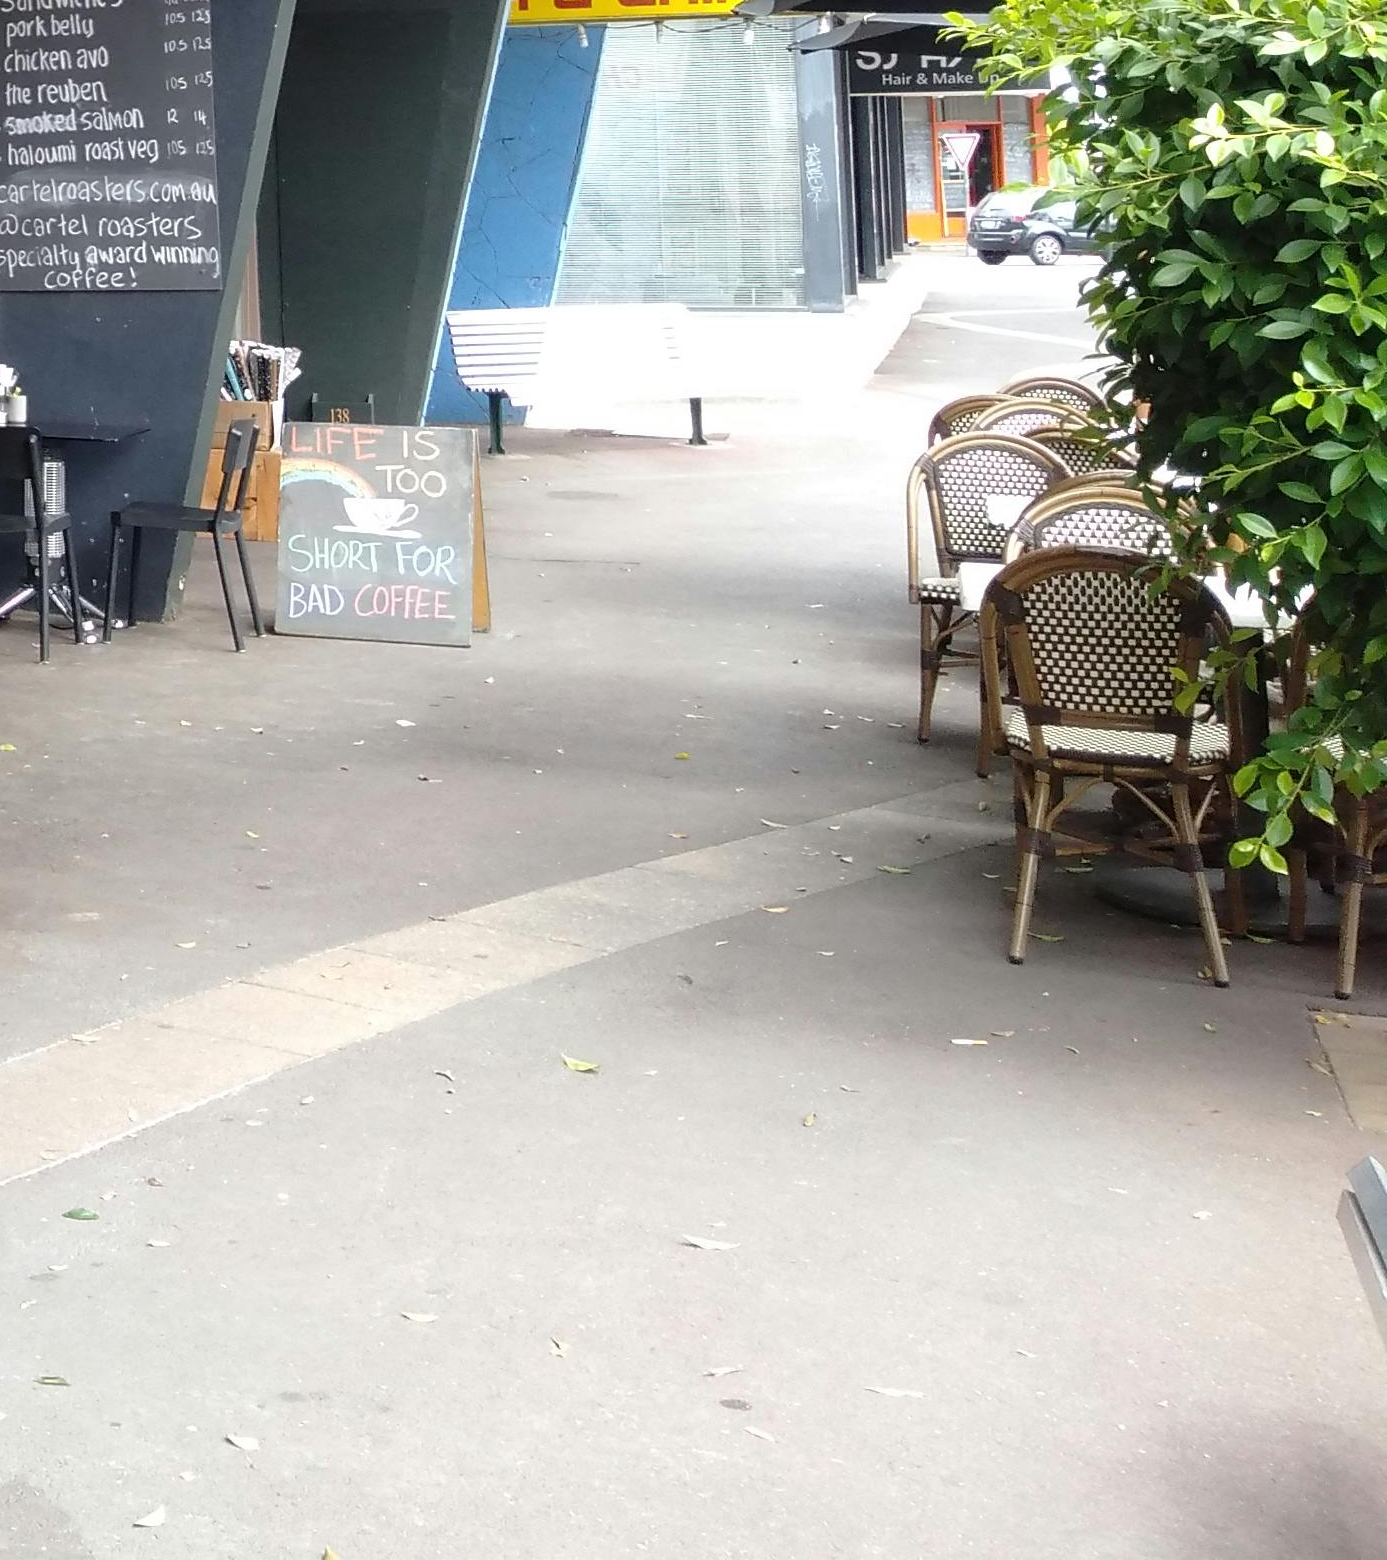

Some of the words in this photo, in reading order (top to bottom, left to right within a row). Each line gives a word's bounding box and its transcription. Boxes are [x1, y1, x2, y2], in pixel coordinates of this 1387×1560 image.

[6, 15, 48, 48] pork
[50, 13, 95, 39] belly
[3, 48, 72, 73] chicken
[76, 46, 109, 71] avo
[4, 82, 33, 107] the
[36, 78, 108, 104] reuben
[882, 73, 912, 86] Hair
[916, 73, 928, 85] &
[933, 71, 974, 85] Make
[3, 109, 77, 136] smoked
[80, 107, 145, 131] salmon
[167, 108, 179, 124] 12
[193, 109, 208, 126] 14
[7, 140, 77, 166] haloumi
[85, 137, 126, 162] roast
[127, 138, 159, 164] veg
[98, 211, 202, 240] roasters
[84, 240, 147, 265] award
[150, 242, 220, 279] winning
[330, 408, 351, 423] 138
[290, 427, 385, 460] LIFE
[403, 430, 440, 461] IS
[375, 465, 447, 497] TOO
[288, 534, 383, 572] SHORT
[395, 541, 458, 584] FOR
[289, 583, 344, 618] BAD
[354, 583, 456, 619] COFFEE
